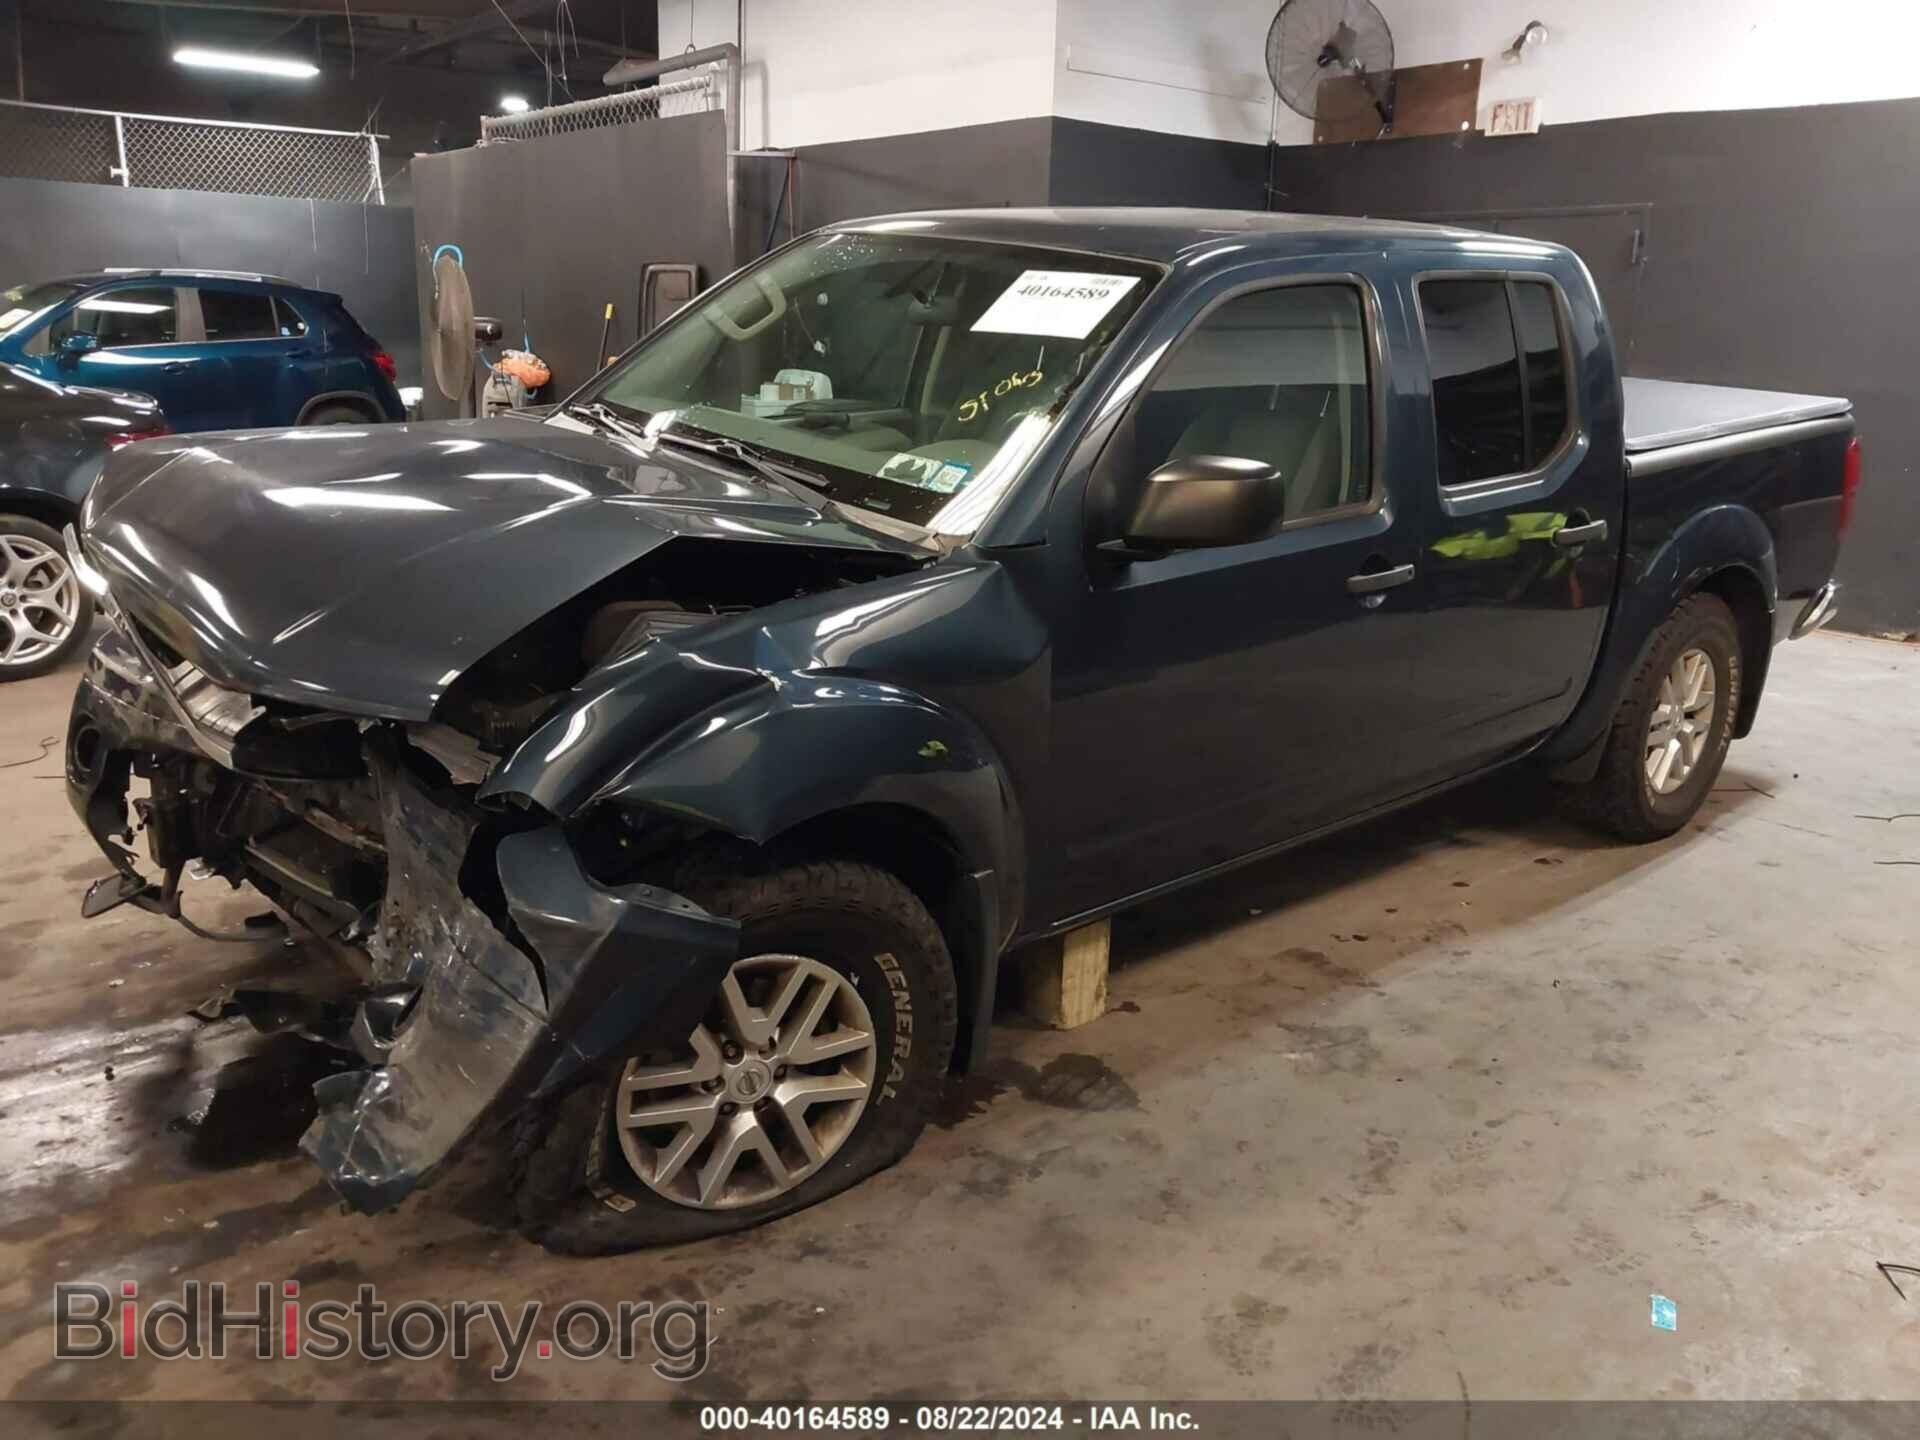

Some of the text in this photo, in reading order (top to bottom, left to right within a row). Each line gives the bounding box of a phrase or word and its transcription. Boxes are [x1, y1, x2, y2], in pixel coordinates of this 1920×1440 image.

[1491, 101, 1536, 133] EXIT
[1017, 284, 1110, 299] 40164589
[873, 952, 913, 1105] GENERAL
